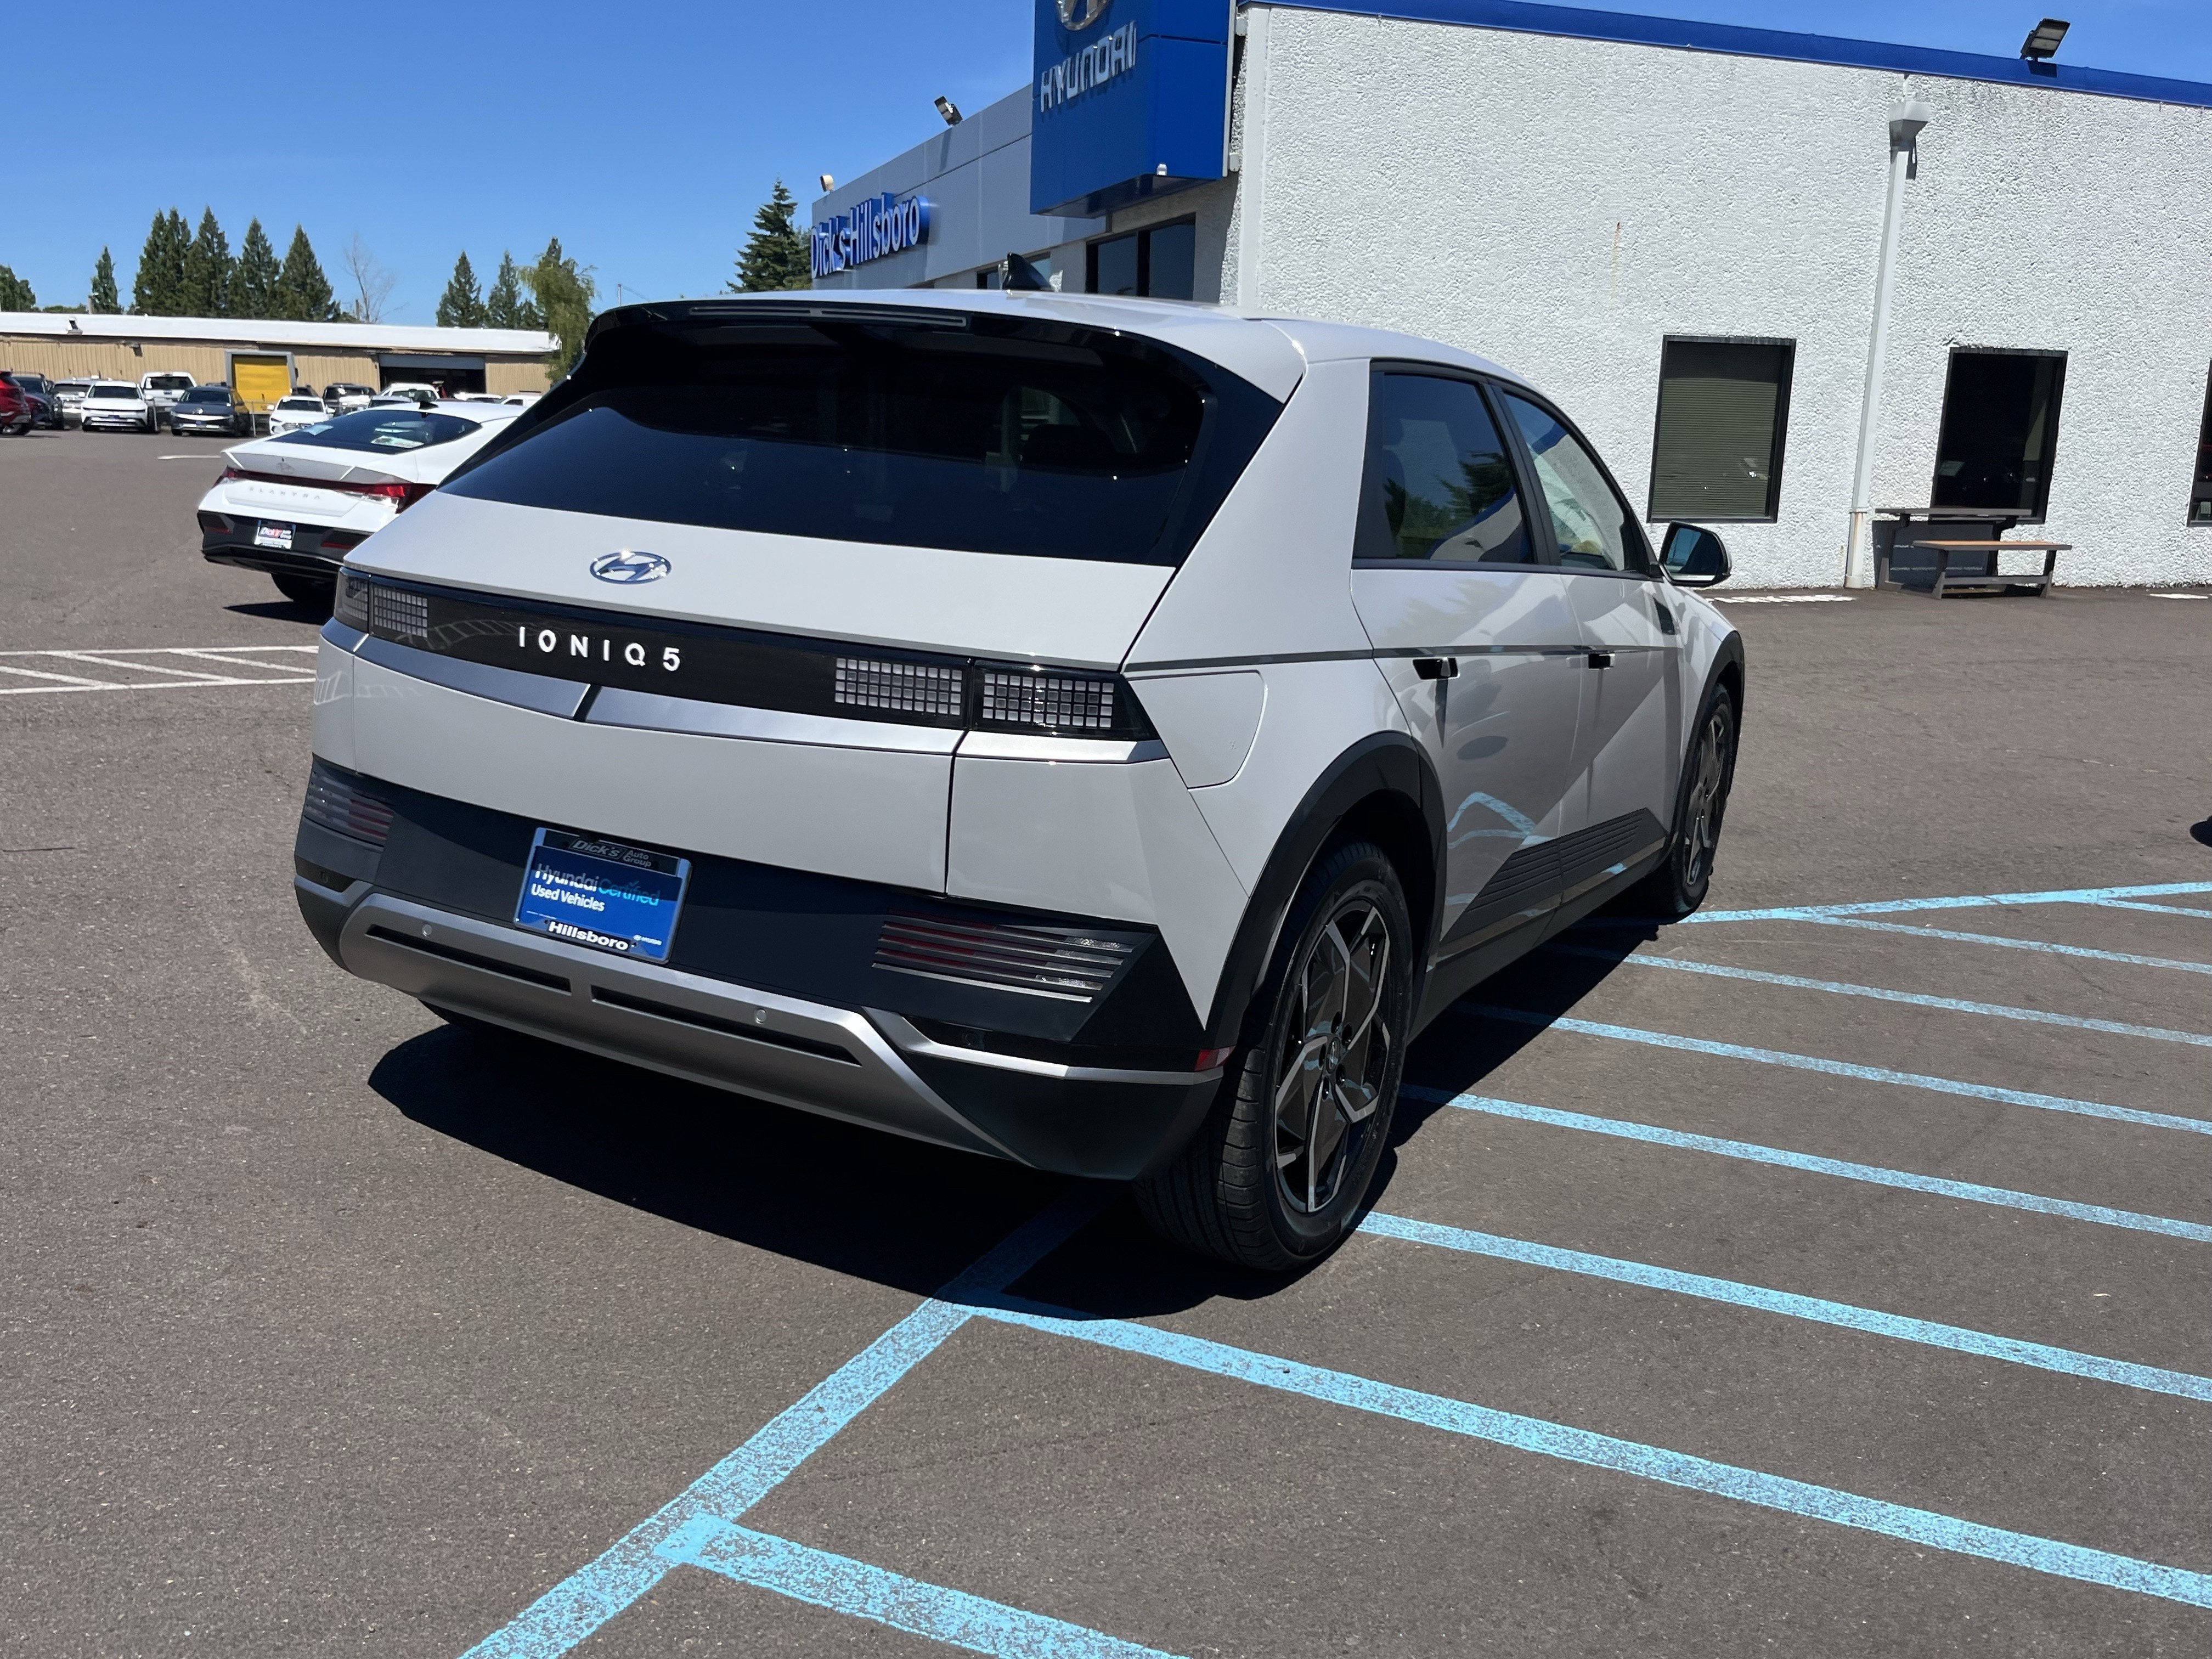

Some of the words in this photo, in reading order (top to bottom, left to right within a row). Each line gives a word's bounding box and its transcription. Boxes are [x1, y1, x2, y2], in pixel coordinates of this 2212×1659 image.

[1041, 20, 1136, 112] HYUNDAI
[811, 216, 847, 279] Dick's
[850, 192, 922, 266] Hillsboro
[250, 486, 320, 499] ELANTRA
[519, 626, 646, 666] IONIQ
[662, 647, 680, 672] 5
[572, 839, 620, 857] Dick's
[623, 854, 652, 867] Group
[628, 850, 649, 860] Auto
[531, 883, 560, 901] Used
[560, 889, 605, 912] Vehicles
[548, 921, 628, 951] Hillsboro
